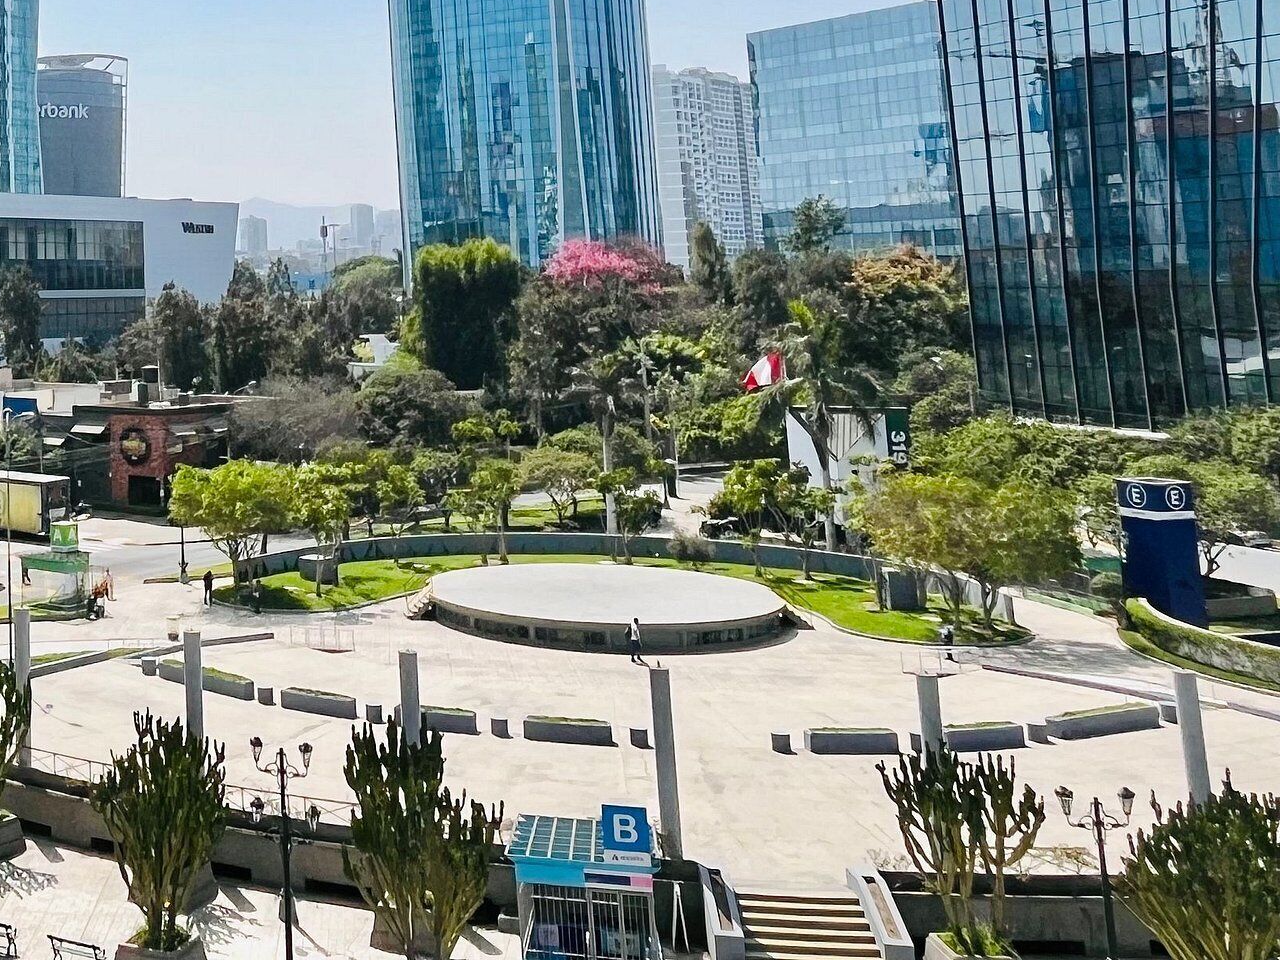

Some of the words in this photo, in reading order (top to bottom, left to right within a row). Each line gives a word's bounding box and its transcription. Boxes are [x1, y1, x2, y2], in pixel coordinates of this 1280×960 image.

[891, 430, 908, 464] 319
[1131, 487, 1142, 503] E
[1170, 490, 1182, 505] E
[613, 813, 639, 843] B
